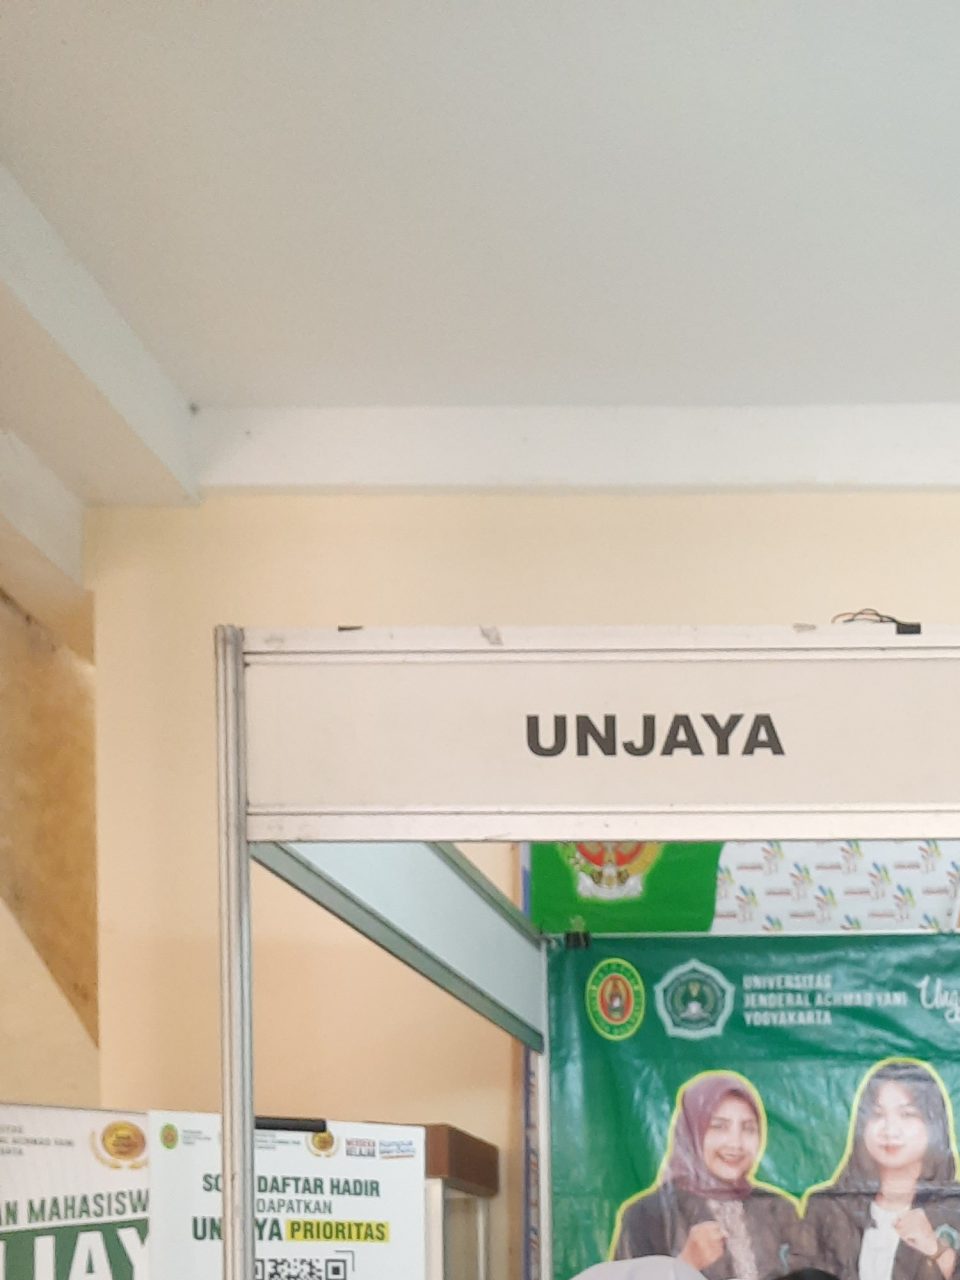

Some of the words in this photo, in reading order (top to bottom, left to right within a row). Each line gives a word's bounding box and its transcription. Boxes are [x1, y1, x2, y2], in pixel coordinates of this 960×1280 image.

[526, 713, 786, 757] UNJAYA
[743, 974, 833, 990] UNIVERSITAS
[743, 992, 812, 1009] JENDERAL
[743, 1010, 833, 1026] YOGYAKARTA
[258, 1176, 324, 1195] DAFTAR
[330, 1177, 381, 1197] HADIR
[290, 1220, 387, 1242] PRIORITAS
